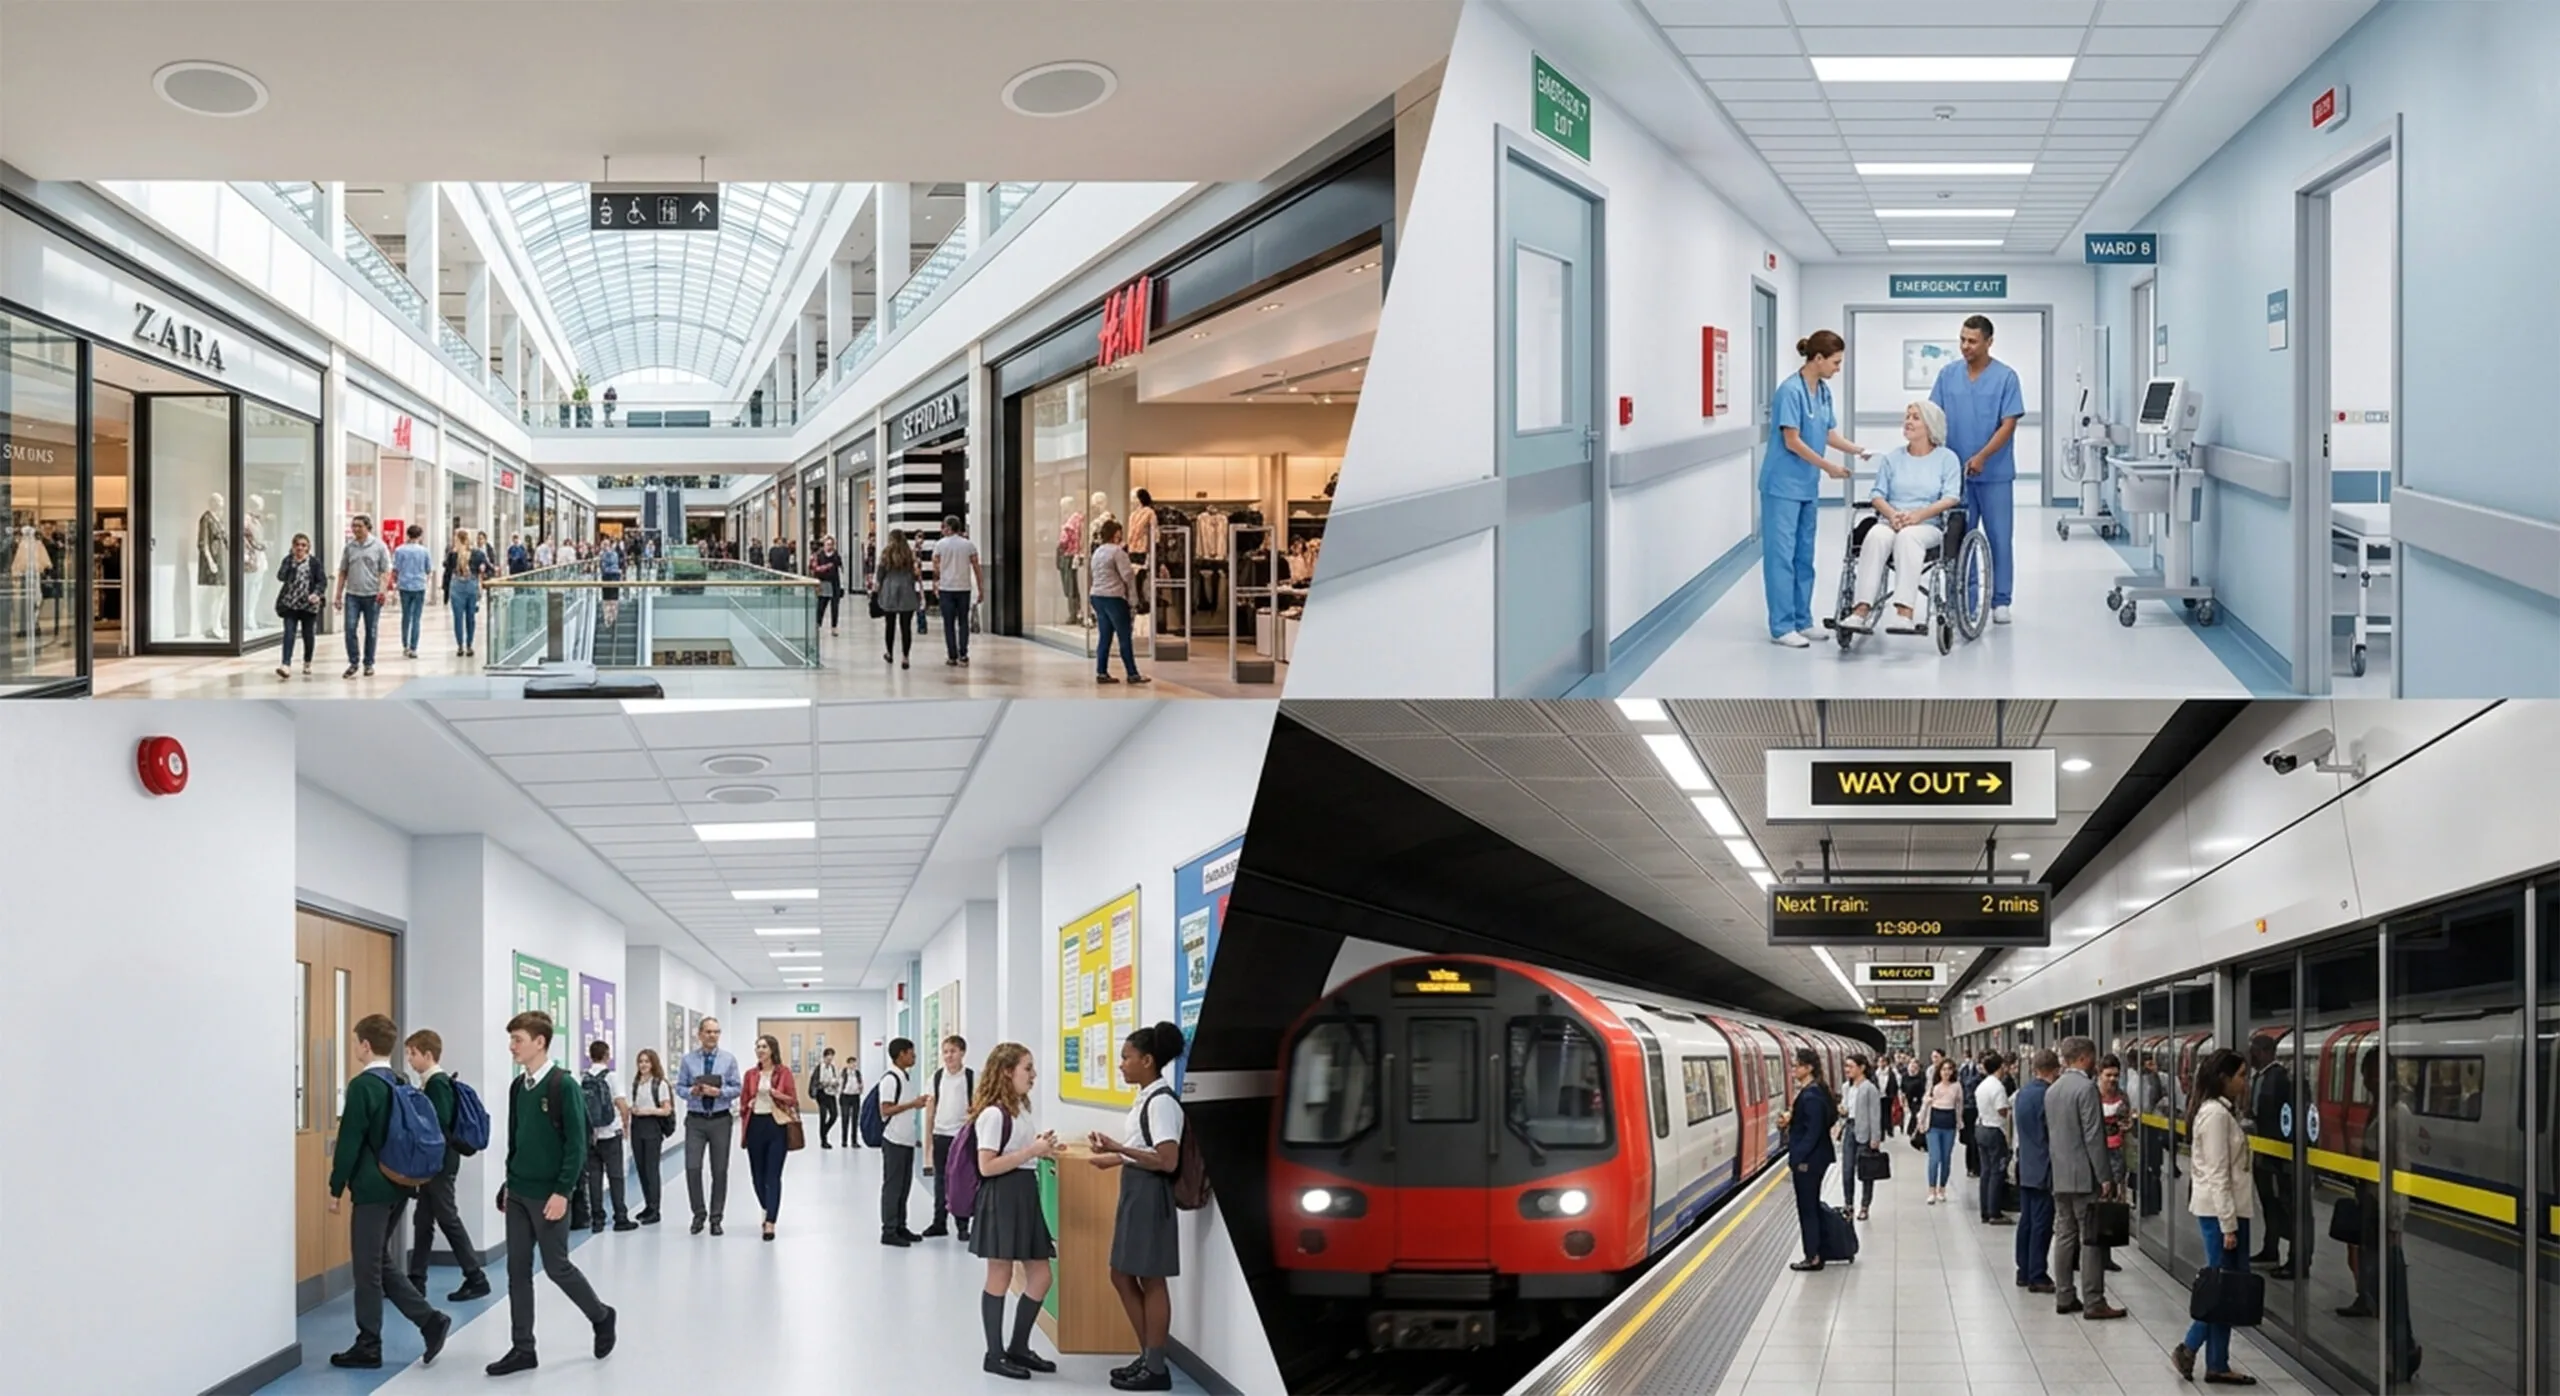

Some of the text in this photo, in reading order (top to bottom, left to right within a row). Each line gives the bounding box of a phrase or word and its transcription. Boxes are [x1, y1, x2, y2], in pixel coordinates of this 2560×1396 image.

[2090, 241, 2150, 256] WARD 8
[133, 302, 225, 371] ZARA
[1838, 772, 1971, 794] WAY OUT
[1777, 895, 1869, 912] Next Train:
[1982, 895, 2039, 912] 2 mins
